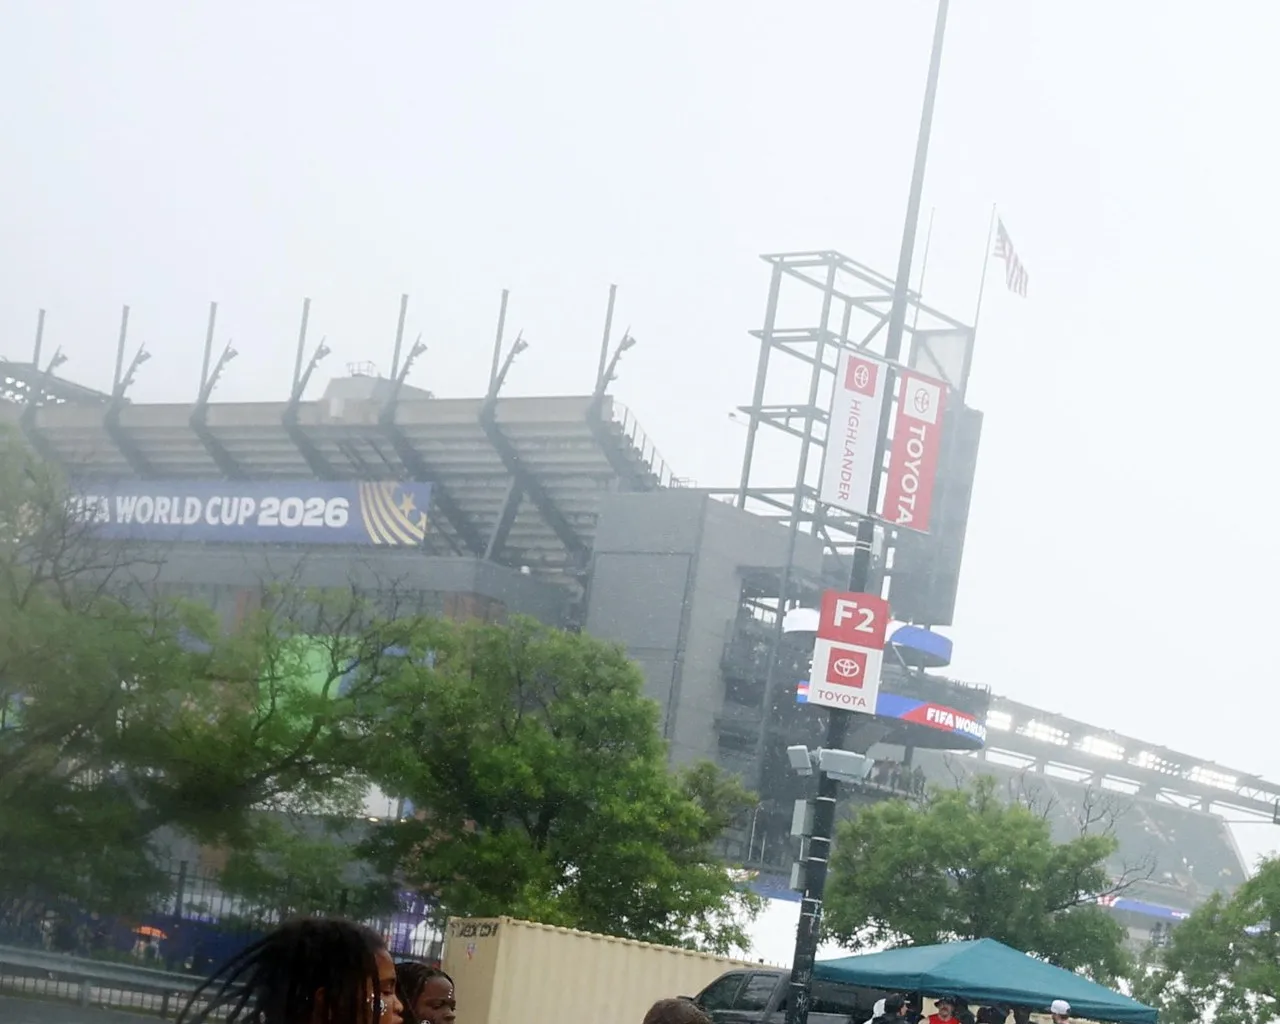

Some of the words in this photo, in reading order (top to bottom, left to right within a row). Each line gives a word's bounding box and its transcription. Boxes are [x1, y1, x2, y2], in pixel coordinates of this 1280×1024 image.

[837, 399, 862, 500] HIGHLANDER
[896, 425, 926, 523] TOYOTA
[116, 496, 202, 525] WORLD
[205, 496, 255, 526] CUP
[258, 496, 349, 527] 2026
[833, 598, 875, 634] F2
[818, 690, 866, 707] TOYOTA
[926, 707, 954, 728] FIFA
